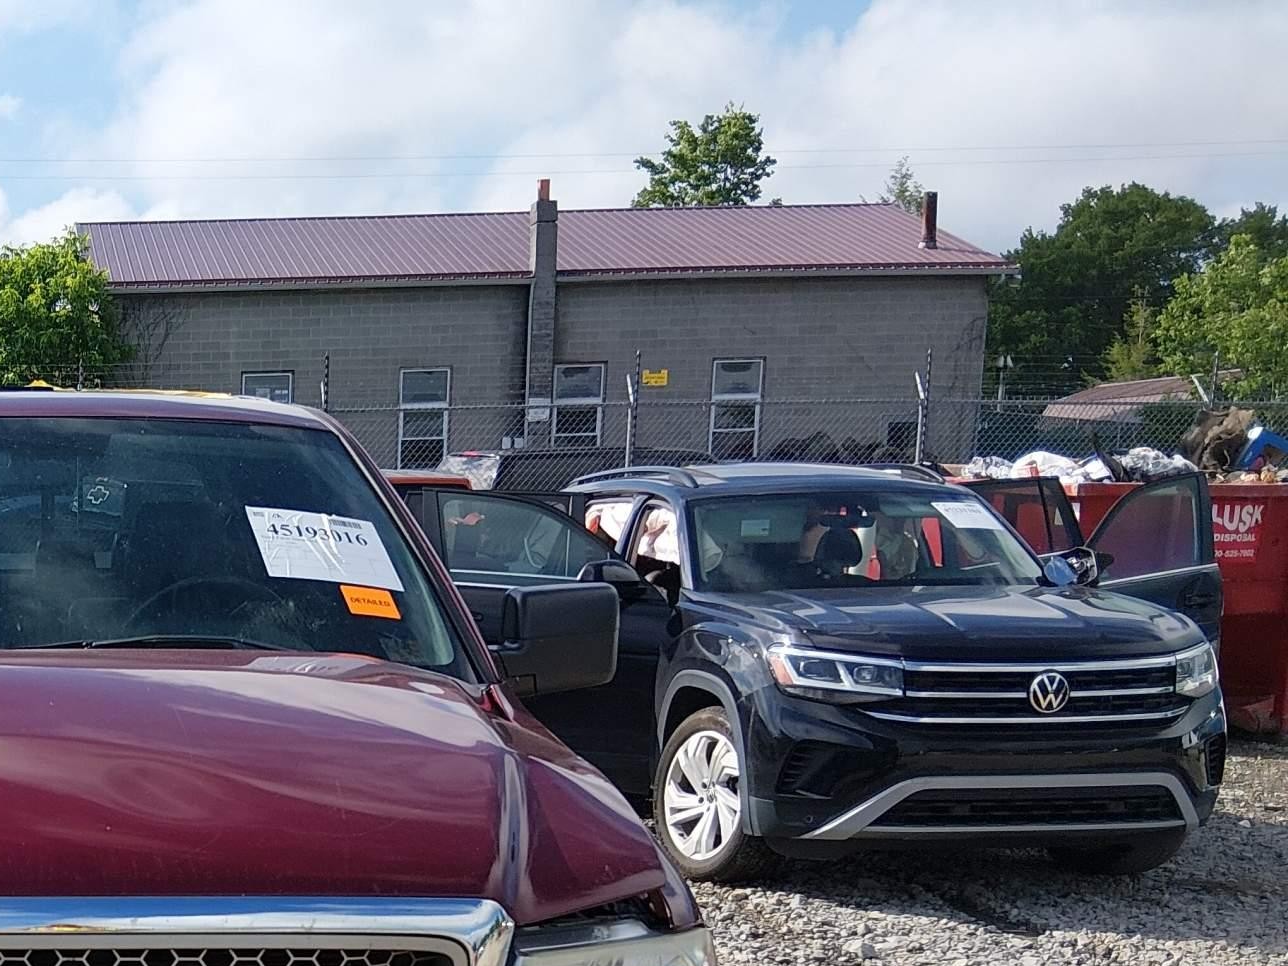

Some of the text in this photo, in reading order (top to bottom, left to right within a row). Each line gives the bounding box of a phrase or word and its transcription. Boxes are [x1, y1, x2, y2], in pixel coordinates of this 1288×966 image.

[1211, 503, 1265, 533] LUSK
[266, 522, 369, 547] 45193016
[1213, 533, 1256, 543] DISPOSAL
